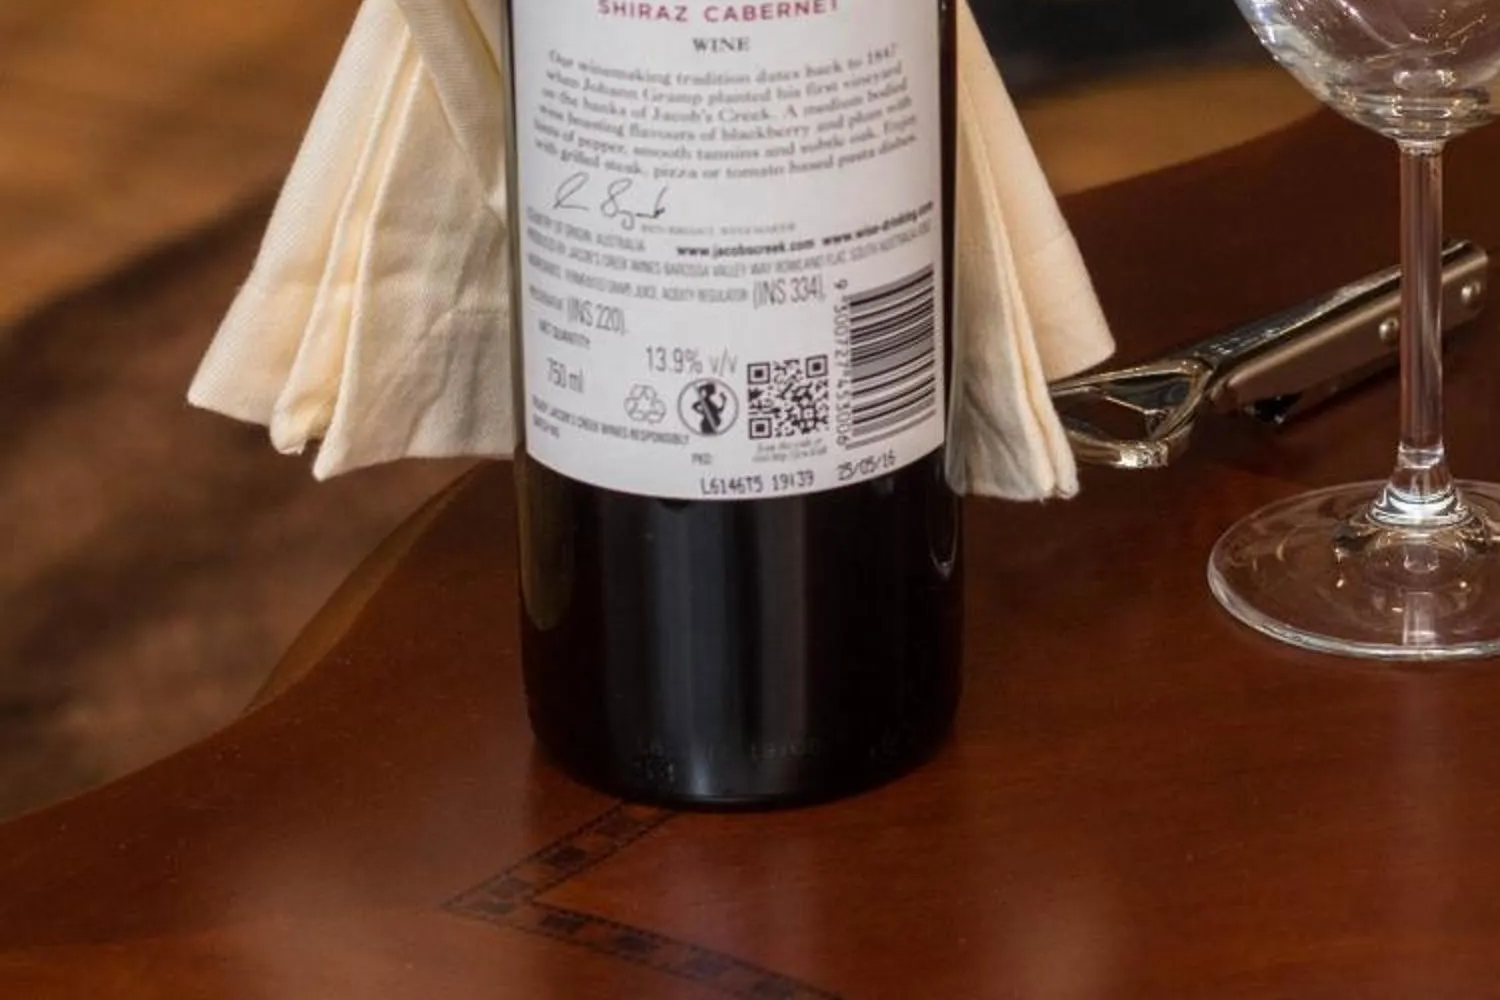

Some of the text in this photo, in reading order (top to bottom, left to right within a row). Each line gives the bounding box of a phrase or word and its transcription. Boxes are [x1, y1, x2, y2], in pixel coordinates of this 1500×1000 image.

[691, 36, 752, 53] WINE
[546, 59, 902, 105] when Johann Gramp planted his first vineyard
[578, 58, 672, 85] winemaking
[677, 72, 749, 85] tradition
[755, 69, 800, 83] dates
[804, 60, 842, 78] back
[847, 59, 863, 69] to
[582, 96, 627, 115] banks
[630, 105, 647, 117] of
[652, 107, 713, 123] Jacob's
[784, 105, 798, 119] A
[803, 96, 864, 115] medium
[867, 76, 908, 102] bodied
[629, 121, 696, 140] flavours
[700, 127, 717, 141] of
[722, 124, 810, 141] blackberry
[816, 114, 844, 132] and
[848, 107, 883, 128] plum
[633, 143, 692, 160] smooth
[696, 148, 760, 160] tannins
[764, 142, 796, 158] and
[800, 134, 845, 154] subtle
[560, 149, 600, 169] grilled
[653, 167, 697, 180] pizza
[702, 169, 720, 179] or
[726, 166, 784, 179] tomato
[788, 154, 833, 174] based
[837, 148, 876, 168] pasta
[645, 344, 704, 376] 13.9%
